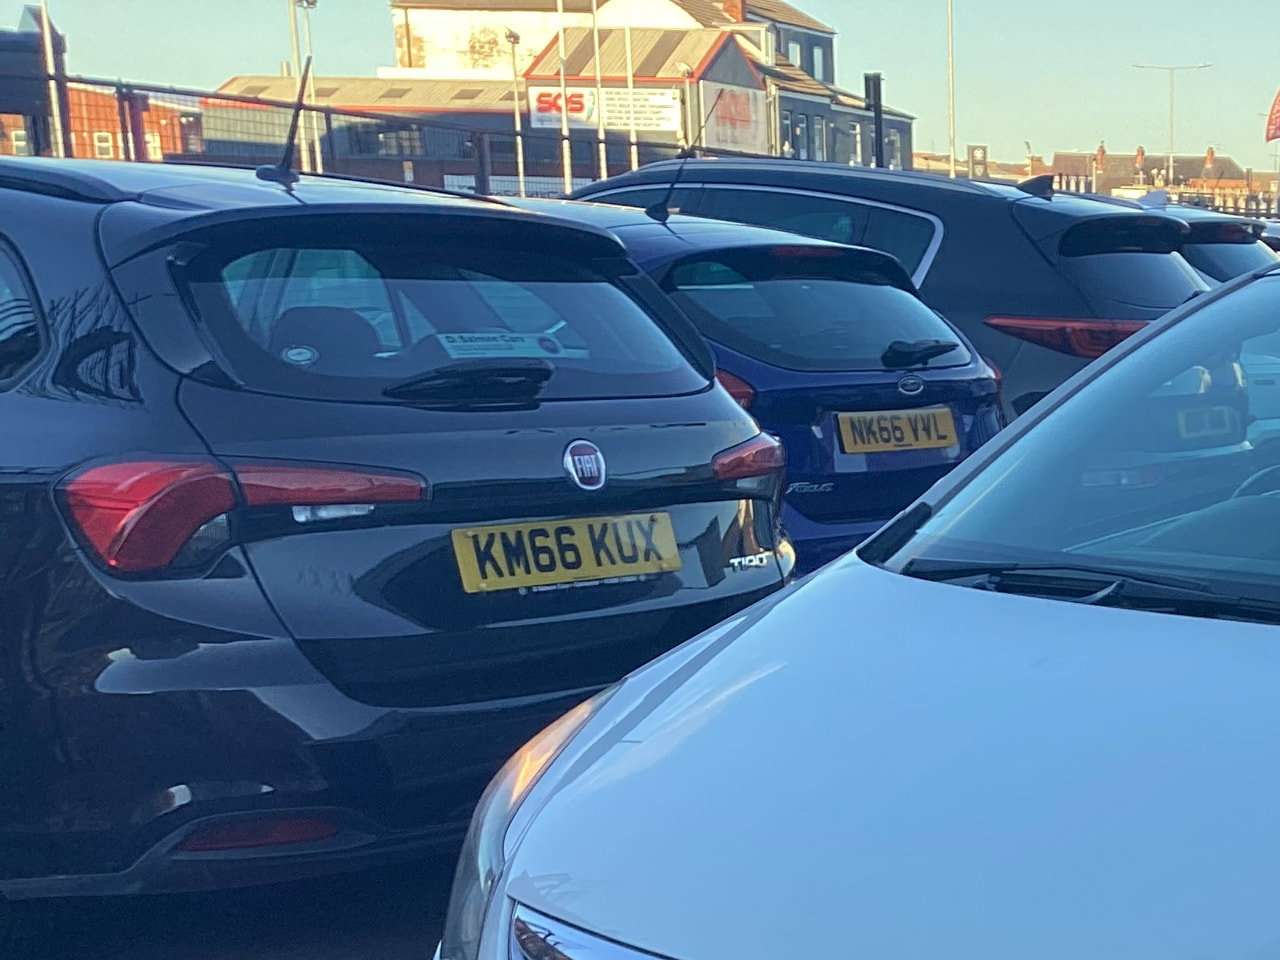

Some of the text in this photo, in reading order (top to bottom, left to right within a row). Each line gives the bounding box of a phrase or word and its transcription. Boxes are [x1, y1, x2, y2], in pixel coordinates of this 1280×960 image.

[850, 415, 905, 446] NK66
[574, 454, 597, 478] FIAT
[471, 520, 663, 580] KM66 KUX
[729, 551, 774, 571] TIPO
